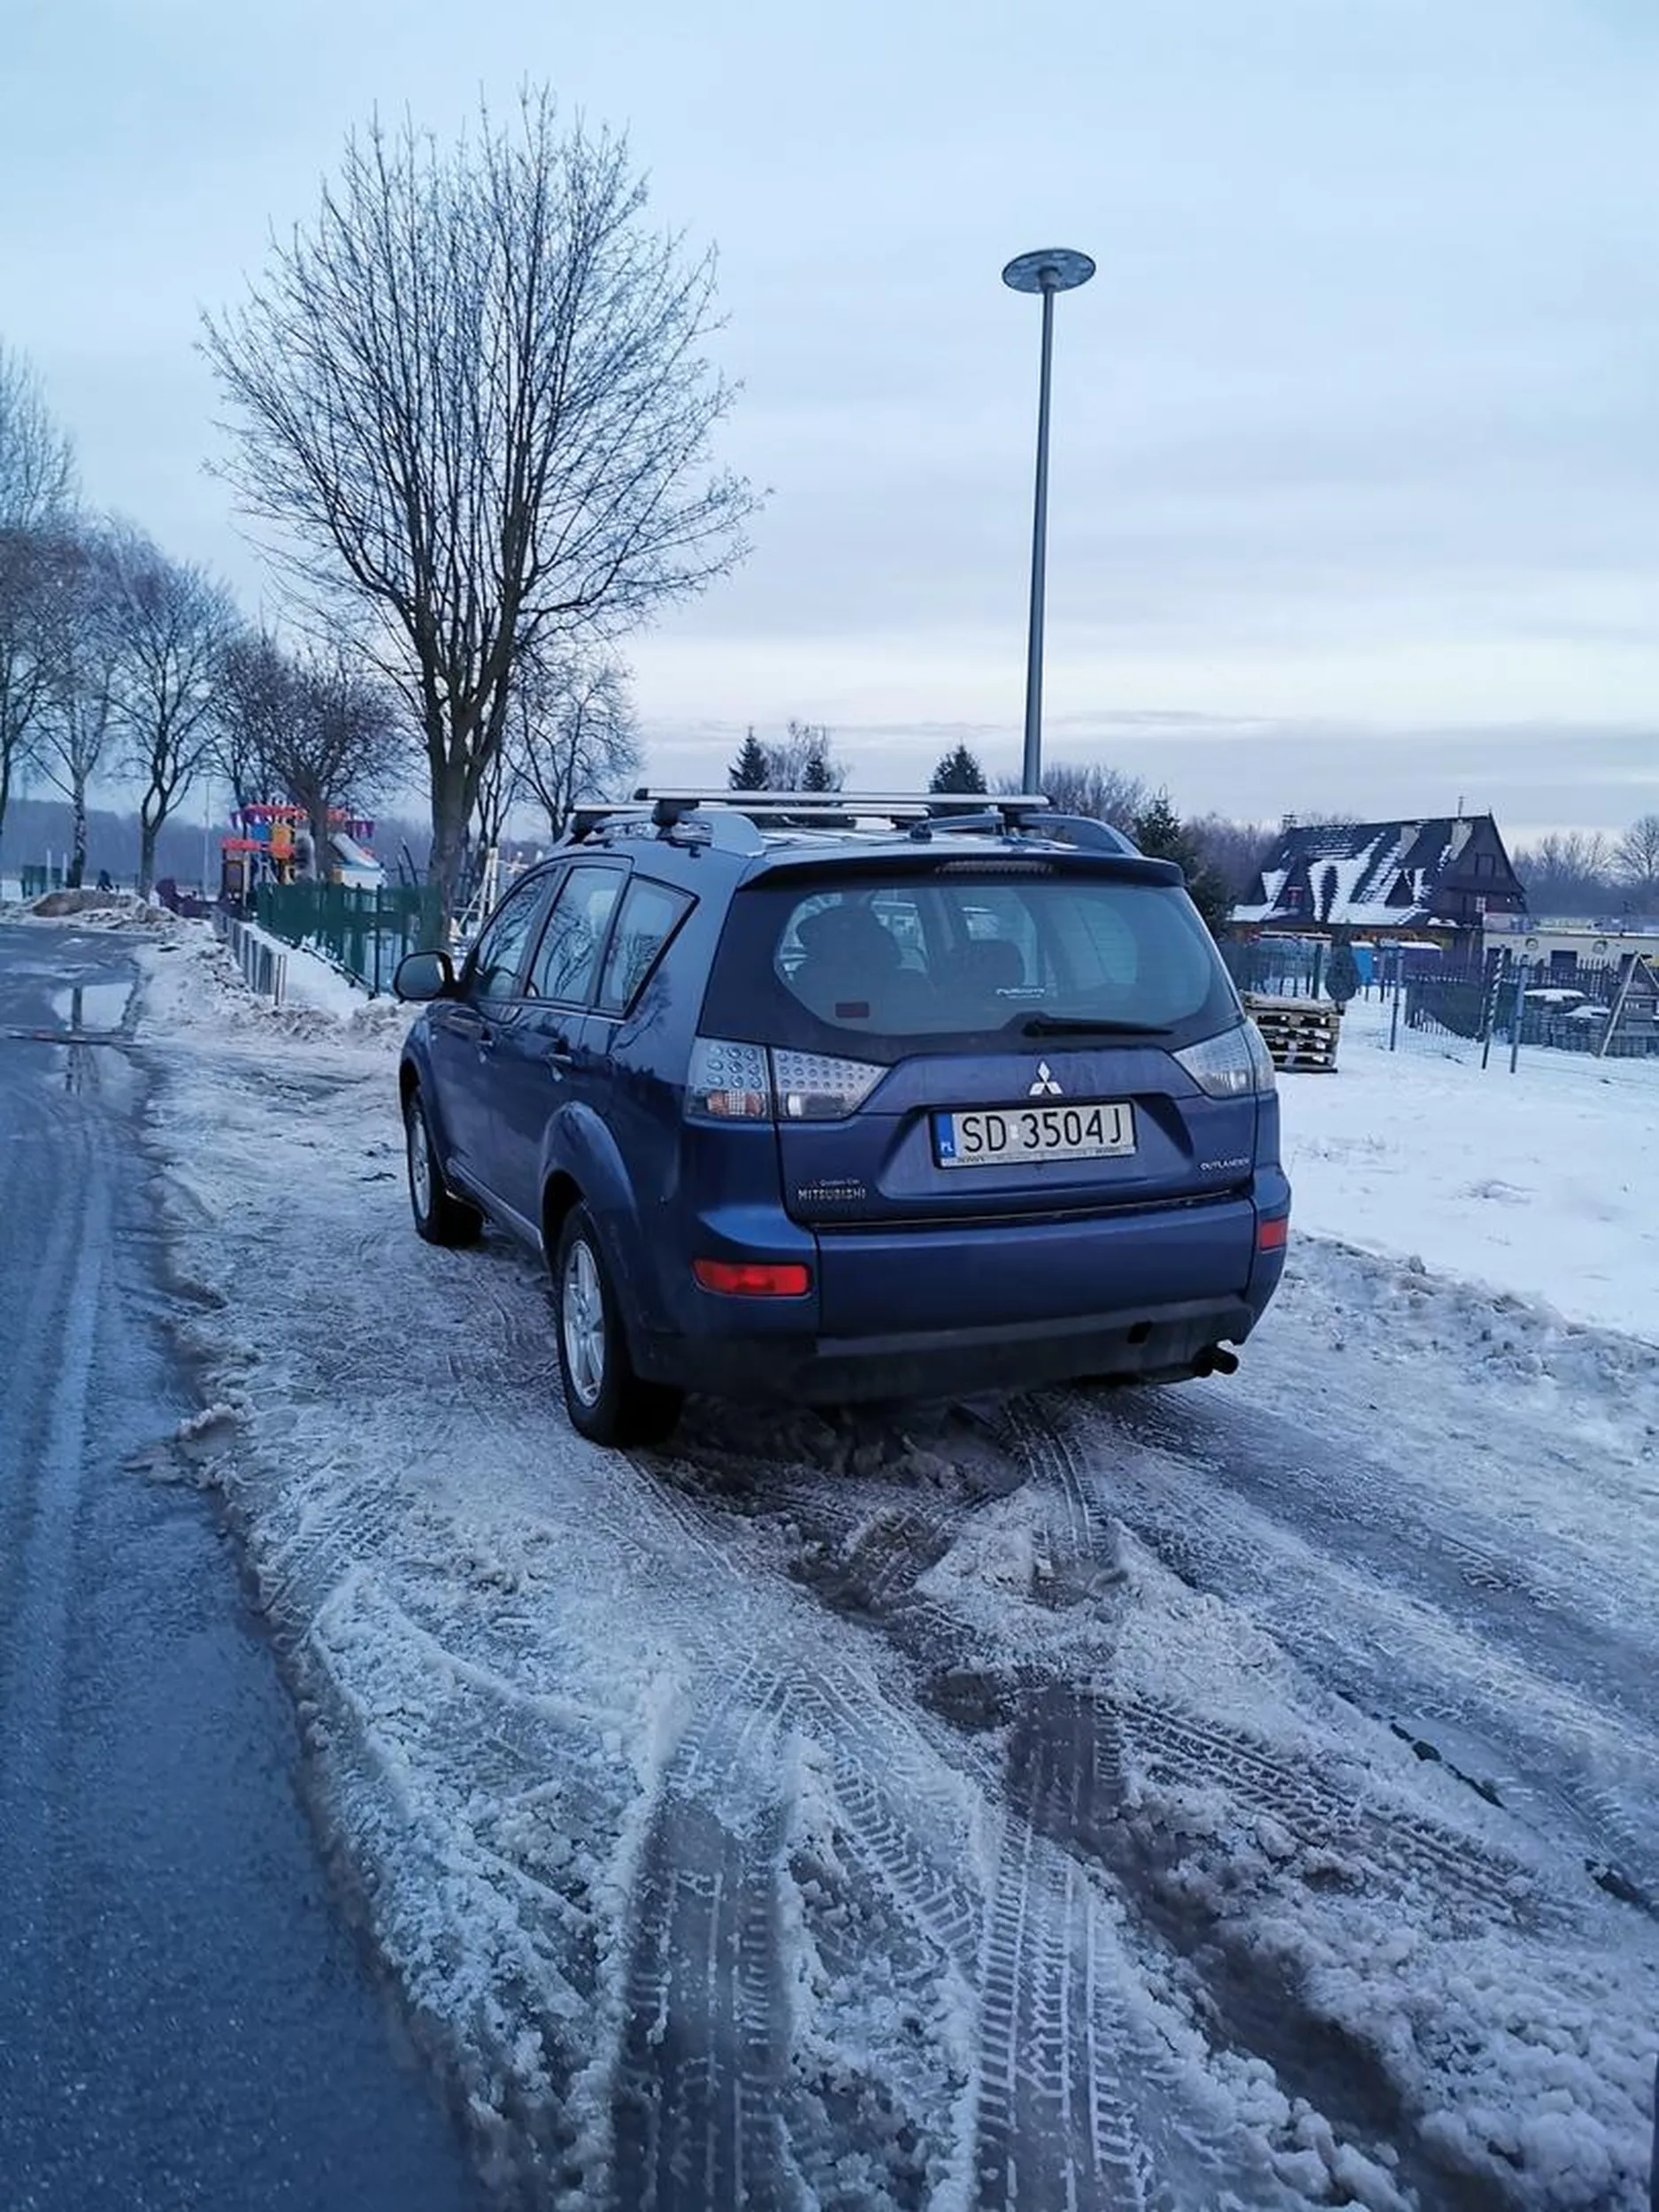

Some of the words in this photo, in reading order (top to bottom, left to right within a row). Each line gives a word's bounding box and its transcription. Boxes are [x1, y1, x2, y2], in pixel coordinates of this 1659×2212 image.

[962, 1115, 1007, 1153] SD
[1021, 1108, 1122, 1149] 3504J
[798, 1188, 866, 1200] MITSUBISHI
